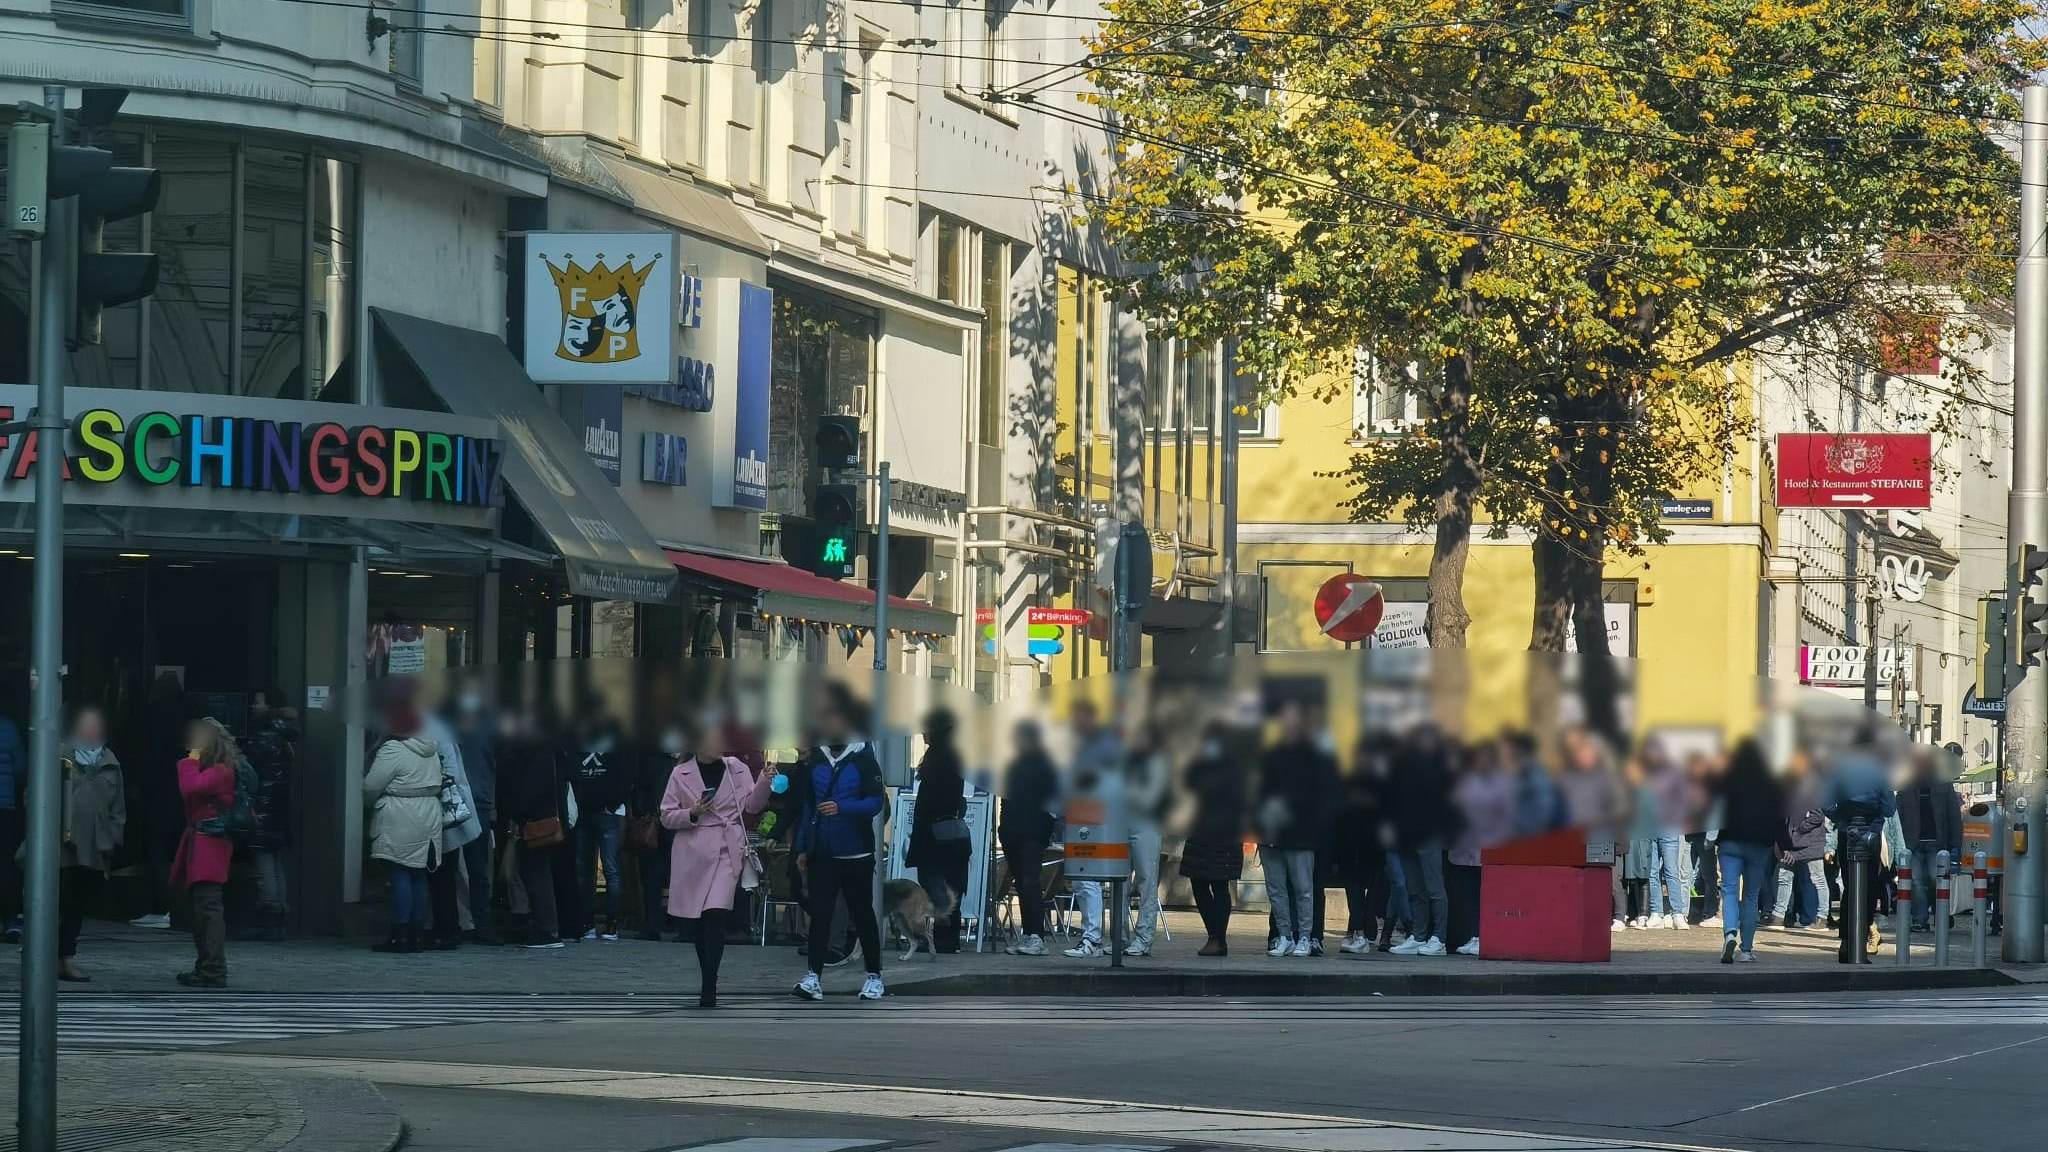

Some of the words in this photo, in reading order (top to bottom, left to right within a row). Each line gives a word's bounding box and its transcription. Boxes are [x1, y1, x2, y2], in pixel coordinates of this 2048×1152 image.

[21, 206, 37, 222] 26
[570, 287, 587, 311] F
[609, 335, 627, 359] P
[648, 431, 687, 486] BAR
[735, 449, 766, 487] LAVAZZA
[1784, 478, 1809, 488] Hotel
[1823, 479, 1868, 488] Restaurant
[1871, 479, 1924, 489] STEFANIE
[1811, 646, 1912, 663] FOOIE
[1811, 664, 1912, 680] FRIGE
